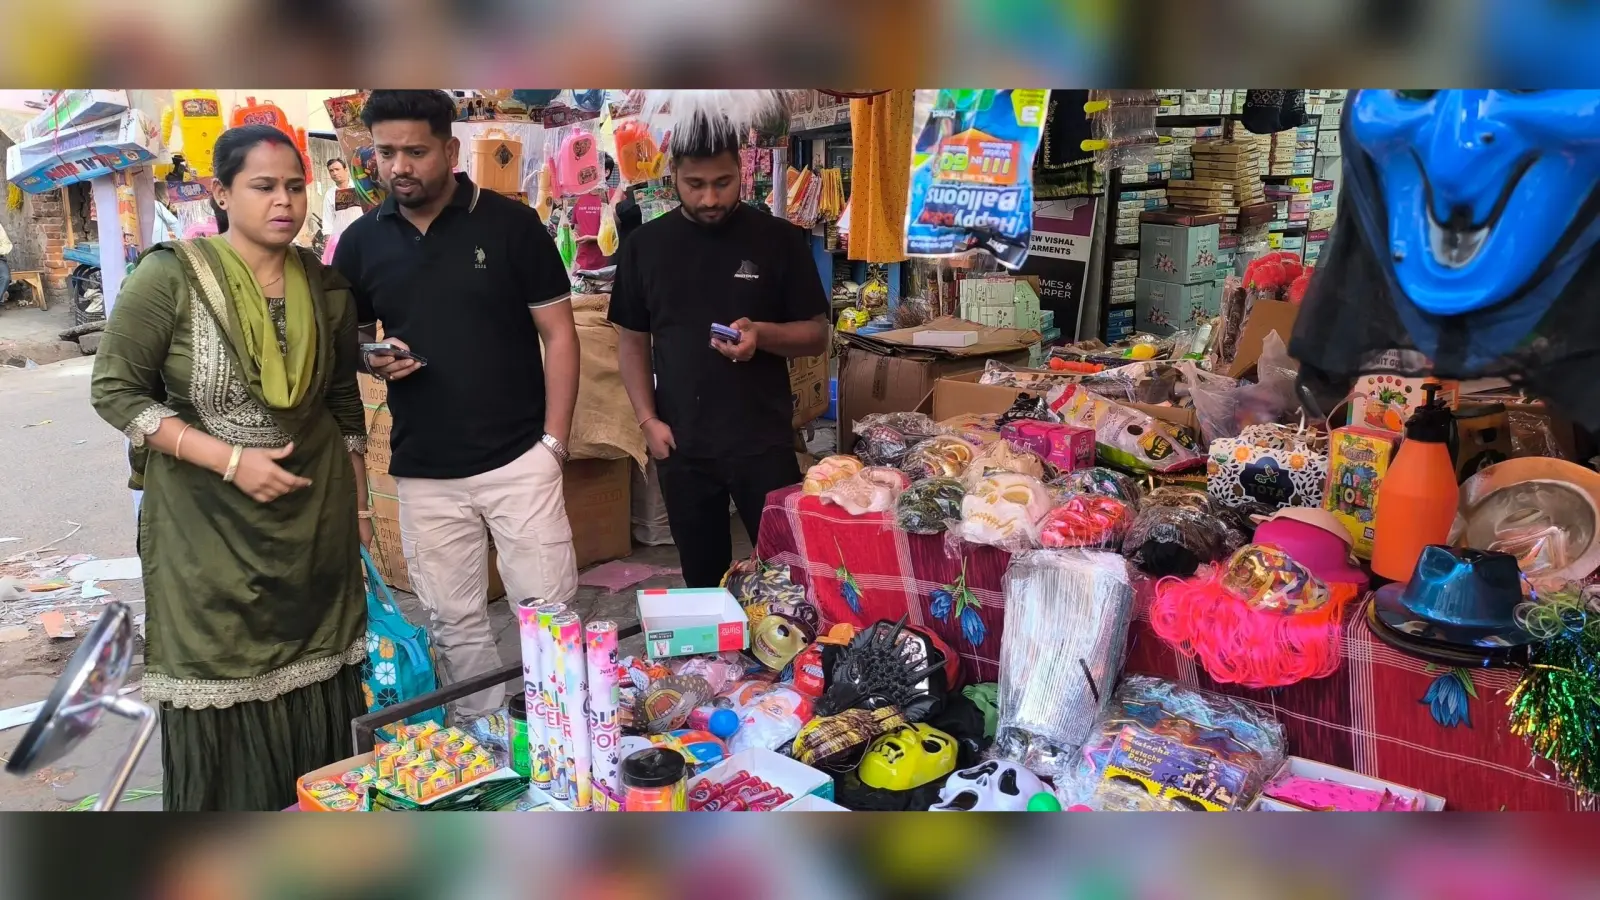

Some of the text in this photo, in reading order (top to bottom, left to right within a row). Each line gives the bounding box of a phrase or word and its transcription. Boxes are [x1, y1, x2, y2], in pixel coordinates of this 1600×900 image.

[926, 187, 1018, 212] Balloons
[1031, 235, 1075, 246] EW VISHAL
[1039, 279, 1064, 288] AMES
[1039, 287, 1072, 298] ARPER
